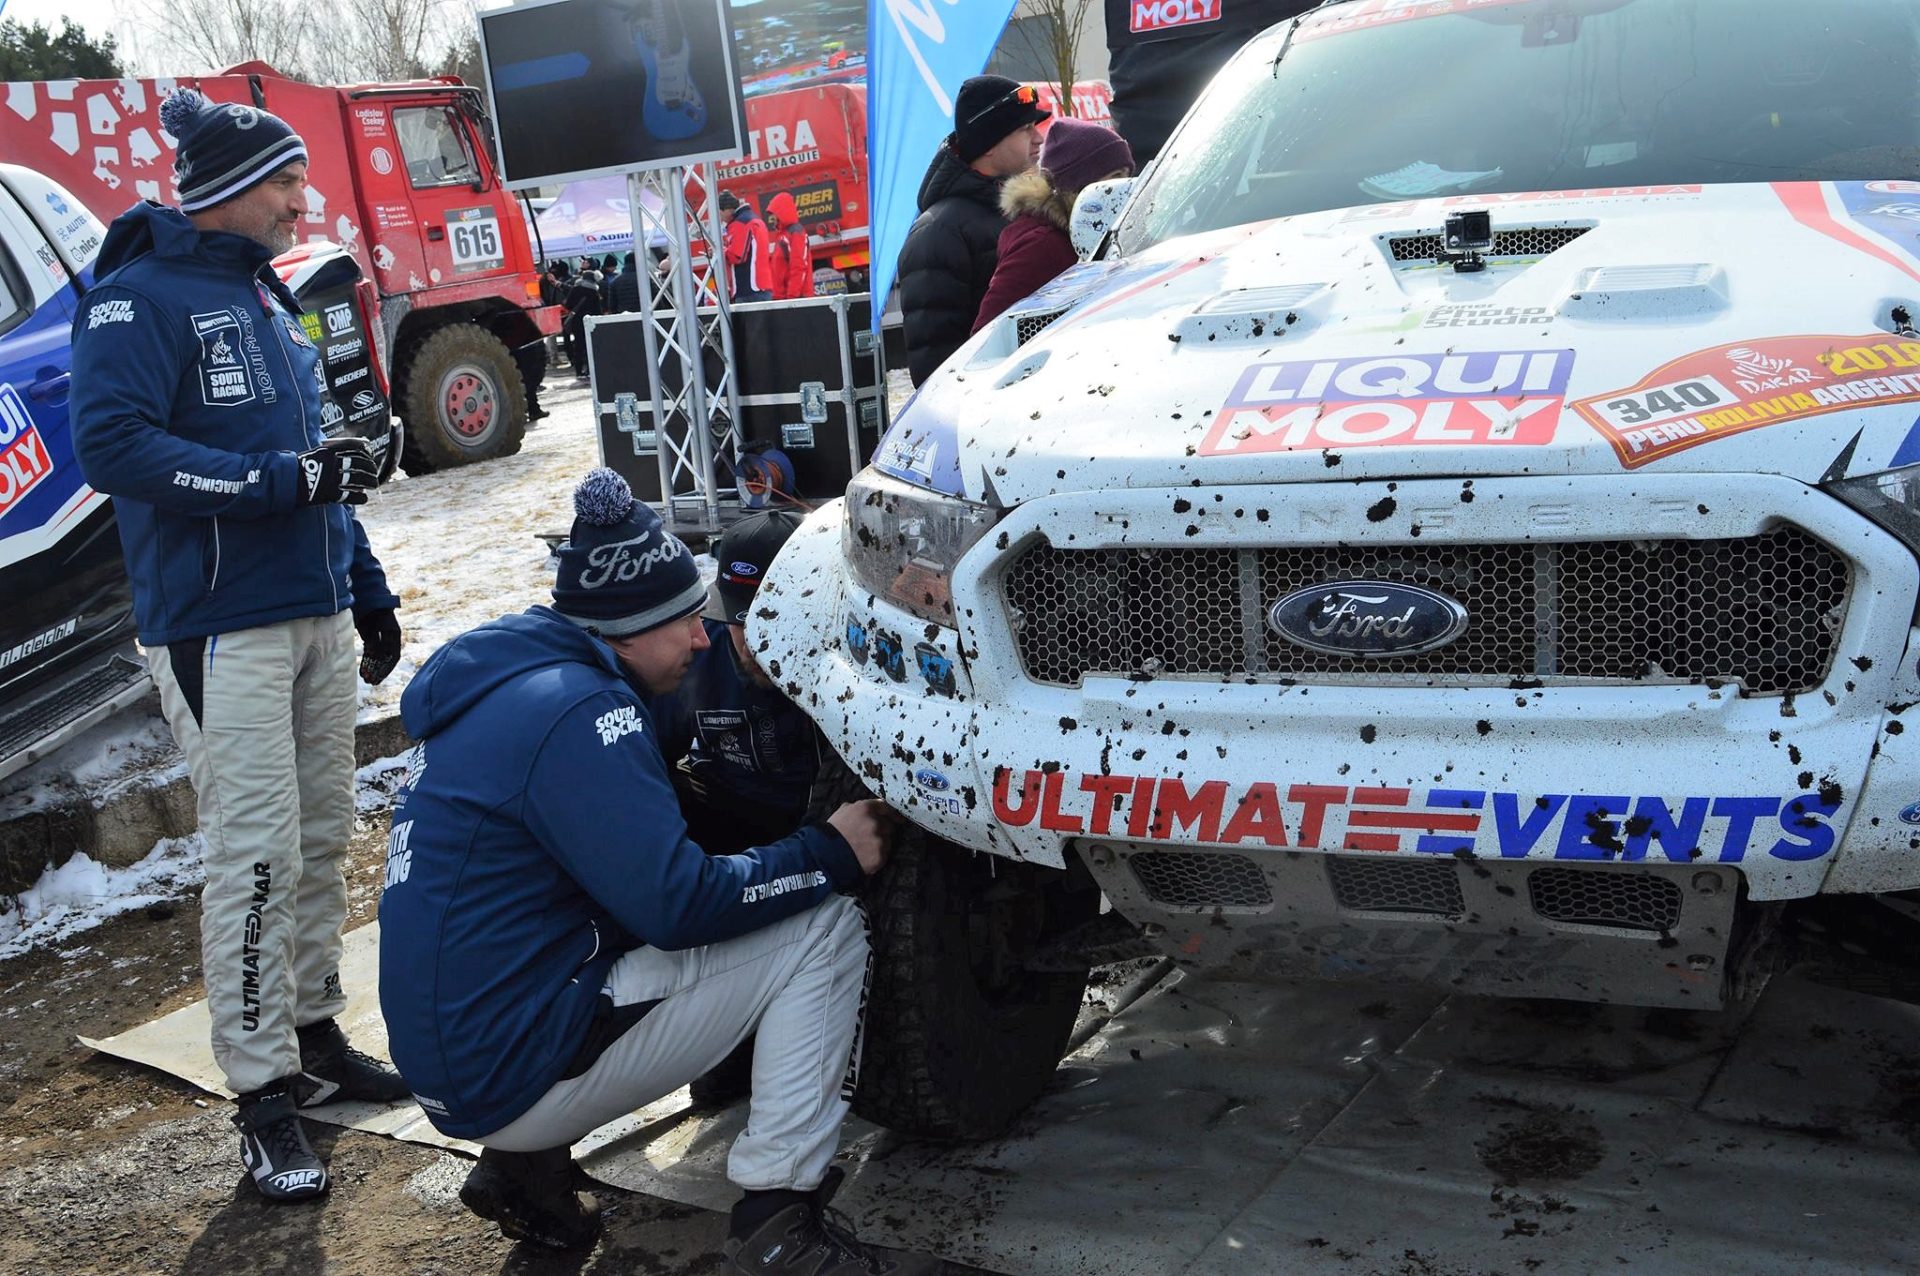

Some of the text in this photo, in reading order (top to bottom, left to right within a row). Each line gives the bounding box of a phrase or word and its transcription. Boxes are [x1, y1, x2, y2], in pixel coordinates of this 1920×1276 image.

[1135, 0, 1214, 28] MOLY
[79, 235, 99, 256] nice
[454, 223, 497, 259] 615
[88, 300, 133, 319] SOUTH
[88, 310, 135, 330] RACING
[327, 307, 353, 332] OMP
[1423, 314, 1555, 329] Studio
[1428, 306, 1547, 320] Photo
[327, 339, 362, 357] BFGoodrich
[210, 371, 246, 387] SOUTH
[335, 366, 368, 388] SKECHERS
[1242, 353, 1560, 403] LIQUI
[1736, 368, 1824, 395] DAKAR
[212, 384, 248, 399] RACING
[1606, 381, 1721, 424] 340
[1213, 398, 1564, 451] MOLY
[1621, 416, 1708, 453] PERU
[1696, 392, 1821, 431] BOLIVIA
[579, 530, 681, 590] Ford
[1308, 592, 1417, 640] Ford
[595, 705, 636, 734] SOUTH
[274, 1172, 321, 1190] OMP
